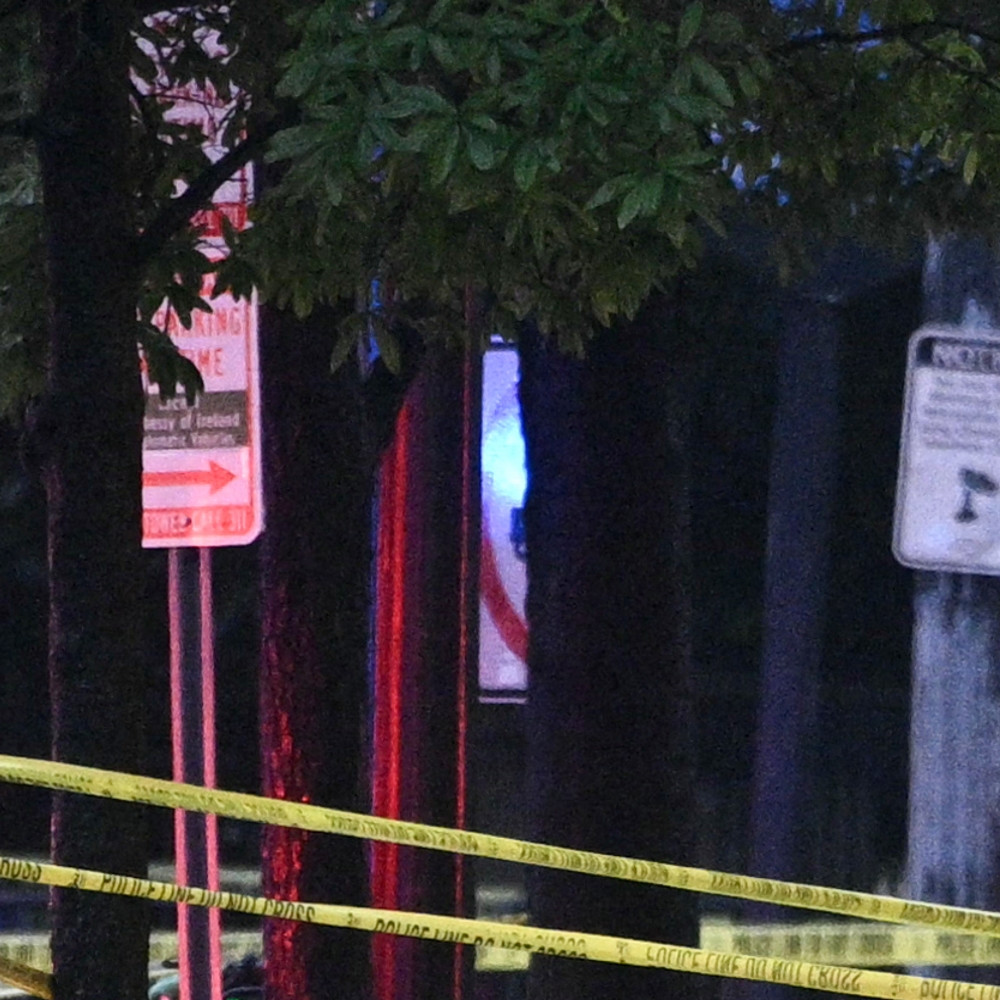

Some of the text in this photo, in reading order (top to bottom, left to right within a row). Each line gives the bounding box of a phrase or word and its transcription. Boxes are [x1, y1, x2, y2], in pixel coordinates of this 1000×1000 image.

[0, 858, 42, 882] ROSS
[101, 870, 156, 897] POLICE
[262, 897, 316, 923] CROSS
